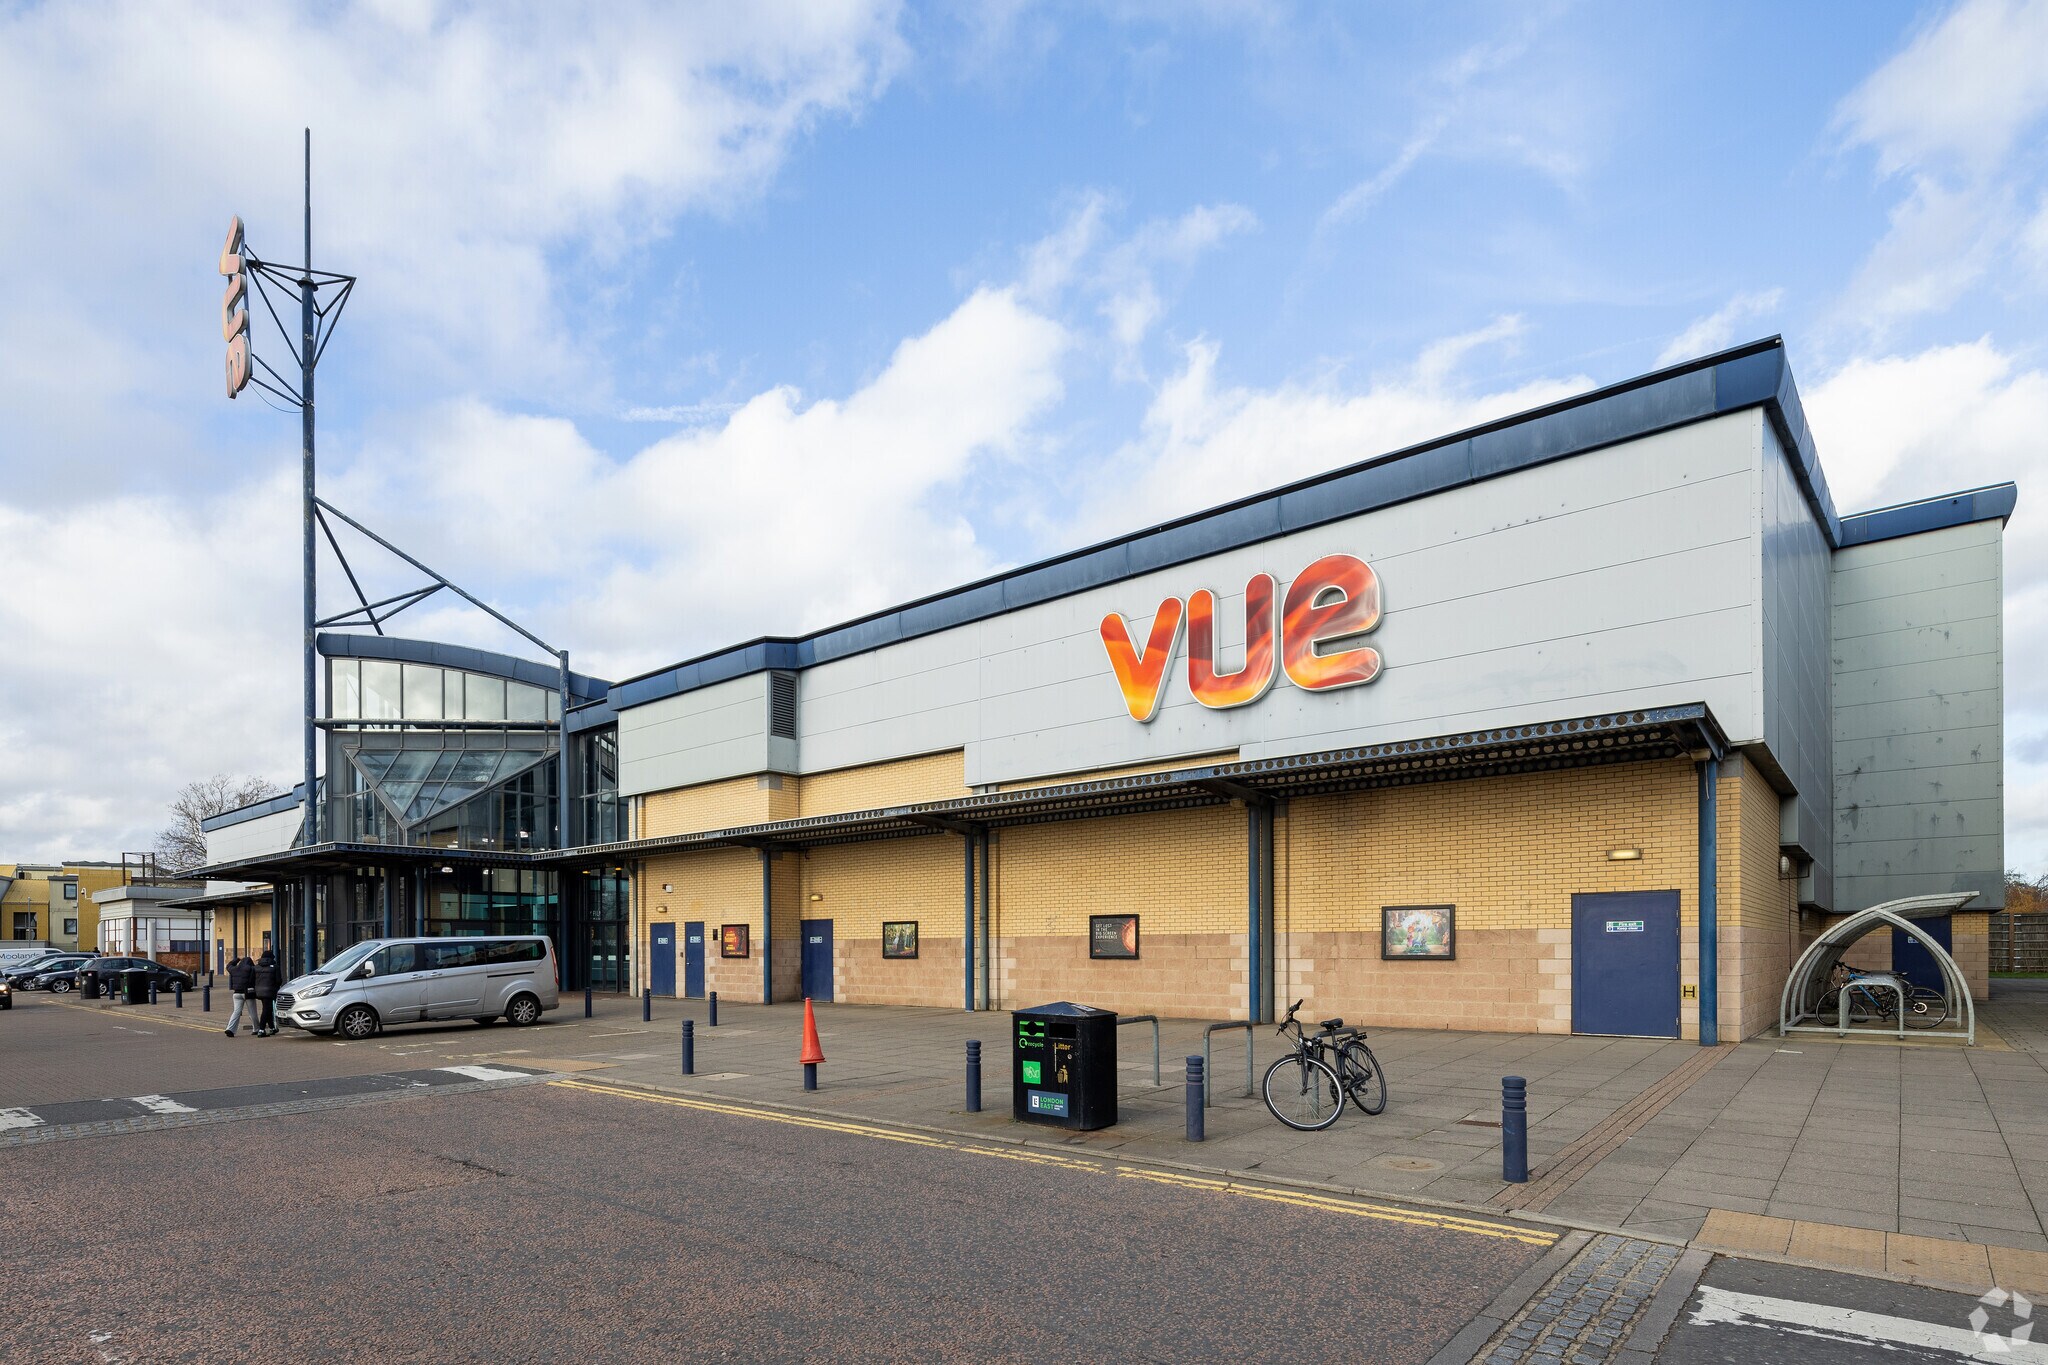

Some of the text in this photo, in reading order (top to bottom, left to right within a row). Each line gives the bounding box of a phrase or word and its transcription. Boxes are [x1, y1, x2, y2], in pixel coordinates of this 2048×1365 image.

[1099, 553, 1385, 723] vue
[1683, 985, 1695, 998] H
[1040, 1096, 1064, 1106] LONDON
